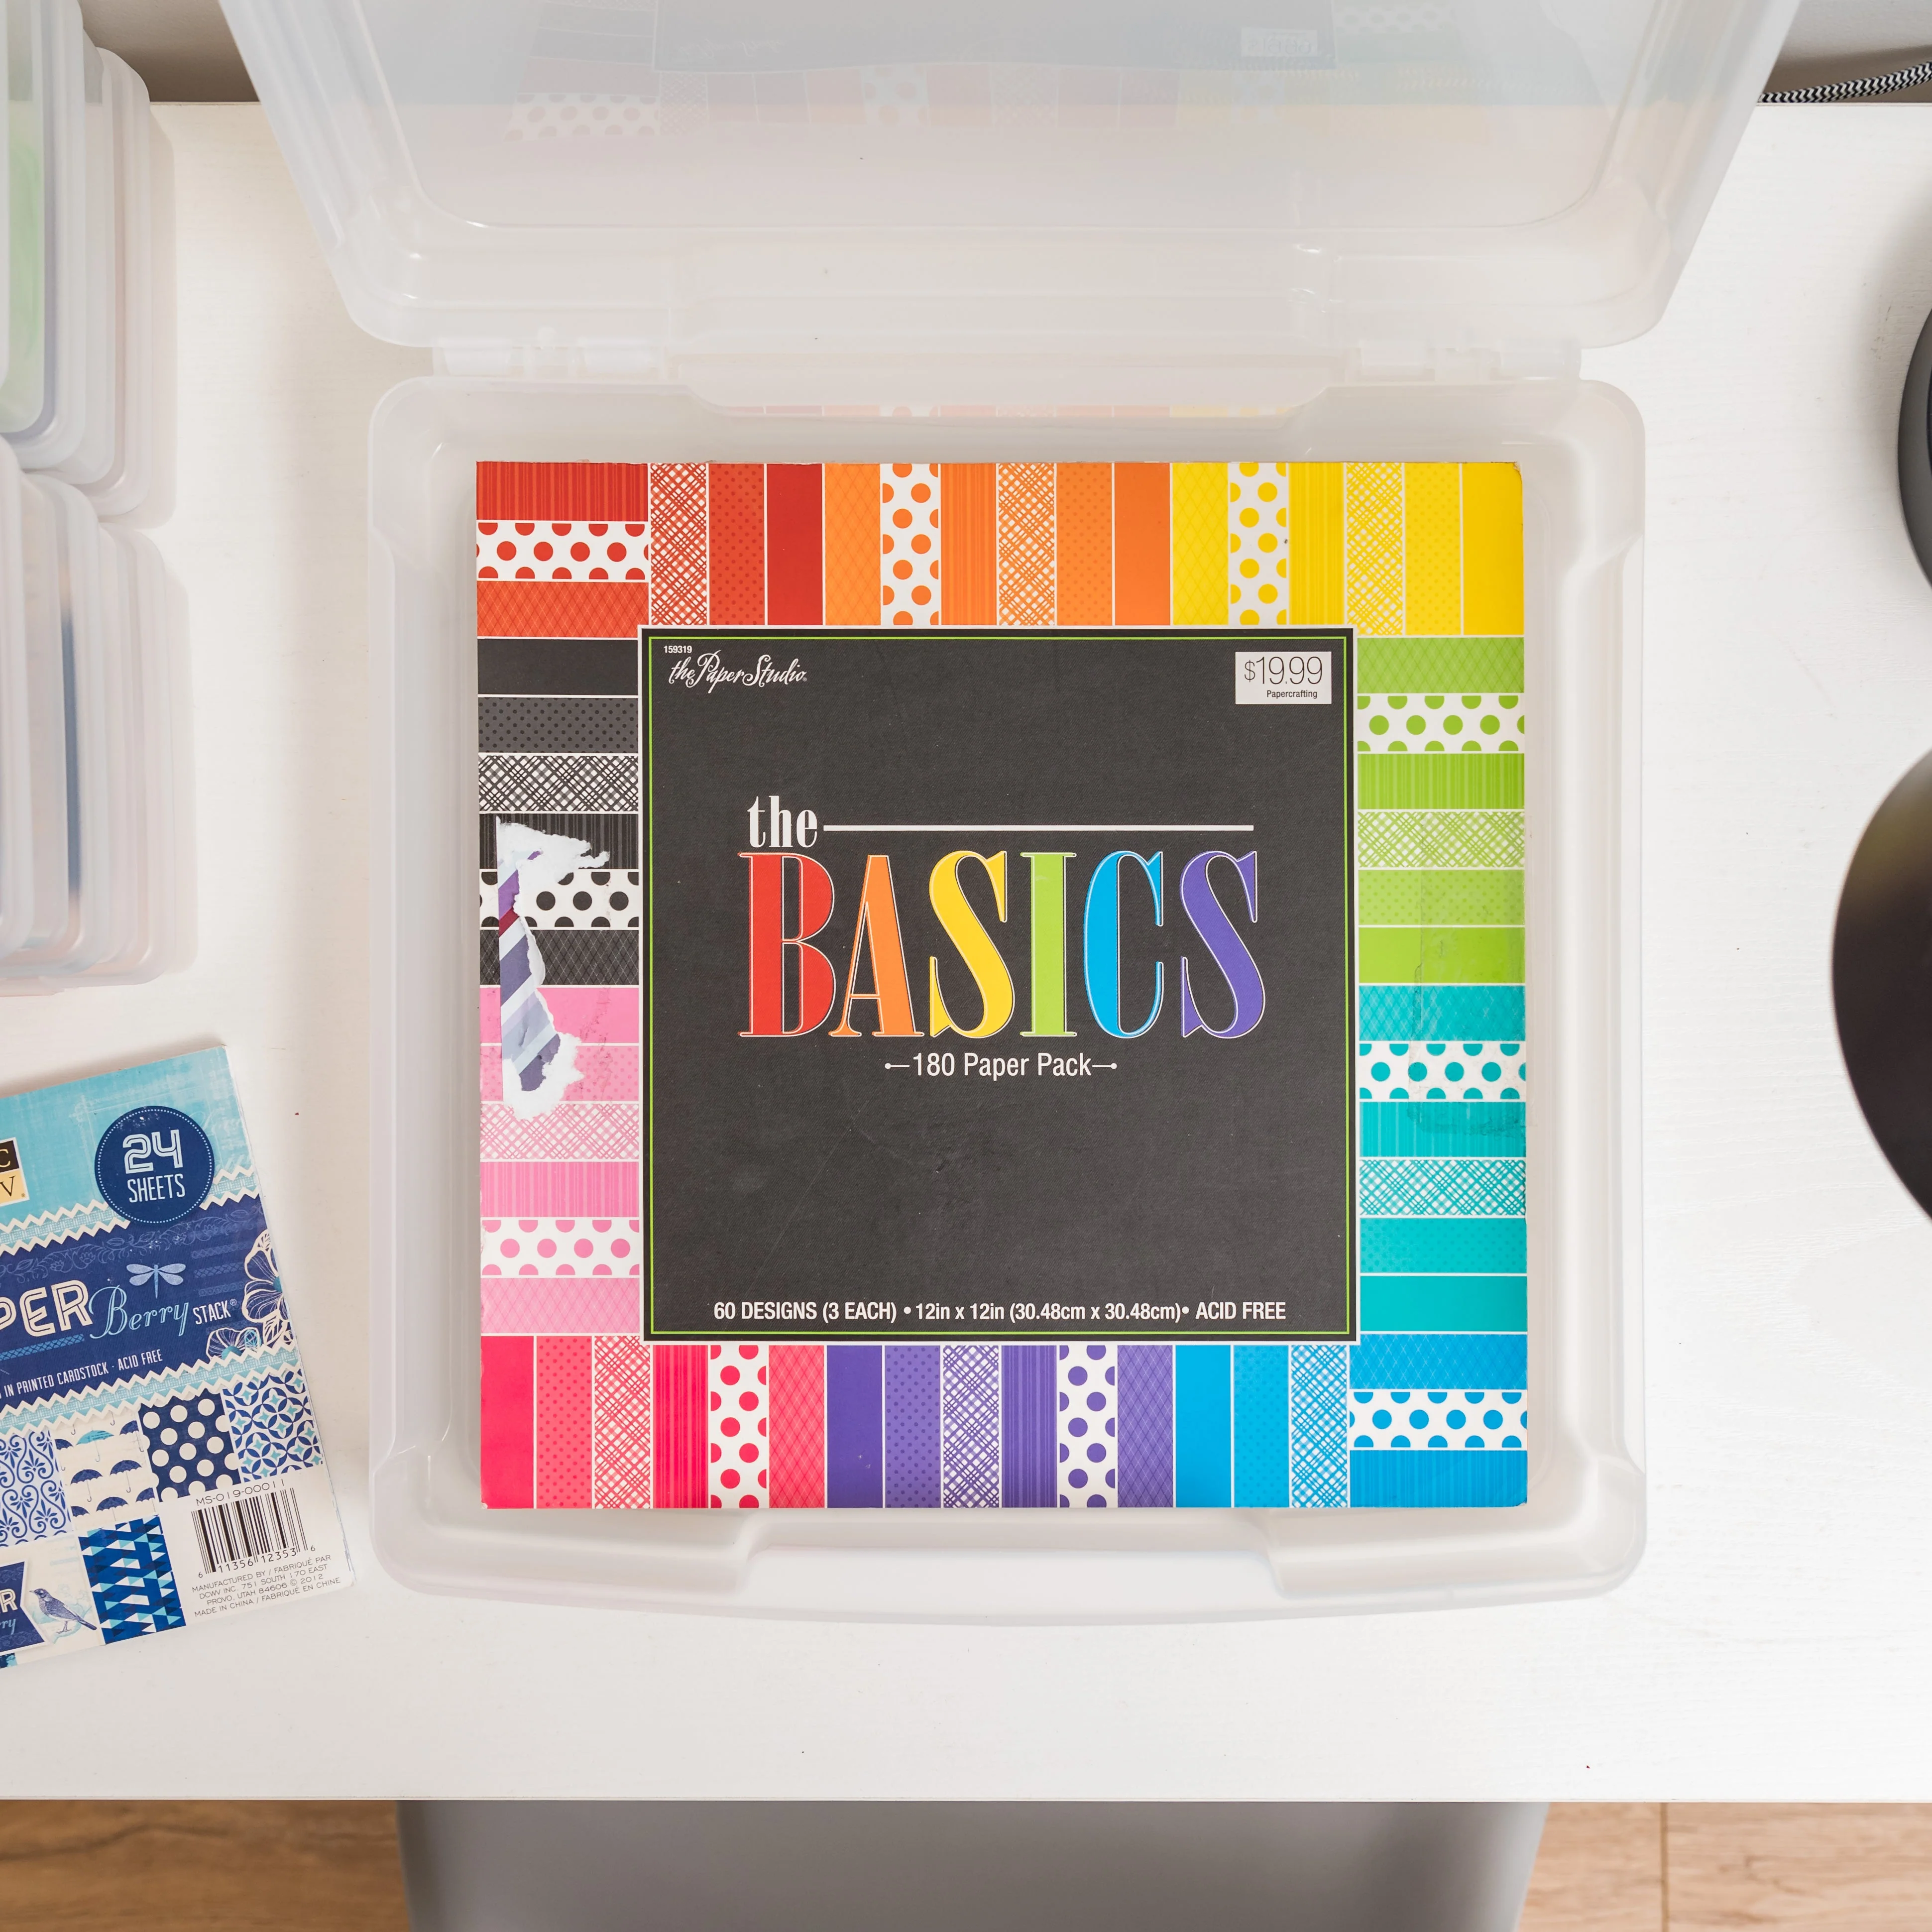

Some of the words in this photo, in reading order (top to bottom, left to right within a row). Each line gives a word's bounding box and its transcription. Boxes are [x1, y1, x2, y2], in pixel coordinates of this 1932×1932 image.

[669, 657, 695, 684] the
[685, 650, 748, 693] Paper
[1244, 656, 1322, 685] $19.99
[1267, 690, 1317, 699] Papercrafting
[747, 796, 817, 848] the
[738, 850, 1266, 1039] BASICS
[913, 1053, 955, 1077] 180
[964, 1053, 1029, 1081] Paper
[1038, 1053, 1092, 1077] Pack
[122, 1129, 184, 1174] 24
[126, 1173, 186, 1203] SHEETS
[89, 1284, 189, 1339] Berry
[714, 1302, 736, 1320] 60
[741, 1302, 817, 1320] DESIGNS
[822, 1301, 839, 1323] (3
[845, 1301, 897, 1323] EACH)
[955, 1307, 965, 1320] x
[970, 1302, 1004, 1320] 12in
[1010, 1302, 1085, 1323] (30.48cm
[1091, 1308, 1100, 1320] x
[1195, 1301, 1237, 1320] ACID
[1243, 1301, 1286, 1320] FREE
[4, 1385, 14, 1397] IN
[16, 1374, 55, 1394] PRINTED
[57, 1362, 109, 1385] CARDSTOCK
[117, 1355, 139, 1370] ACID
[141, 1349, 163, 1365] FREE
[192, 1574, 253, 1592] MANUFACTURED
[274, 1557, 313, 1573] FABRIQUÉ
[316, 1555, 331, 1563] PAR
[218, 1559, 253, 1573] 11356
[261, 1548, 297, 1563] 12353
[261, 1574, 286, 1585] SOUTH
[309, 1564, 328, 1573] EAST
[194, 1607, 217, 1617] MADE
[229, 1599, 254, 1609] CHINA
[262, 1586, 300, 1601] FABRIQUÉ
[316, 1577, 341, 1588] CHINE
[237, 1590, 256, 1598] UTAH
[259, 1583, 287, 1593] 84606
[301, 1574, 323, 1584] 2012
